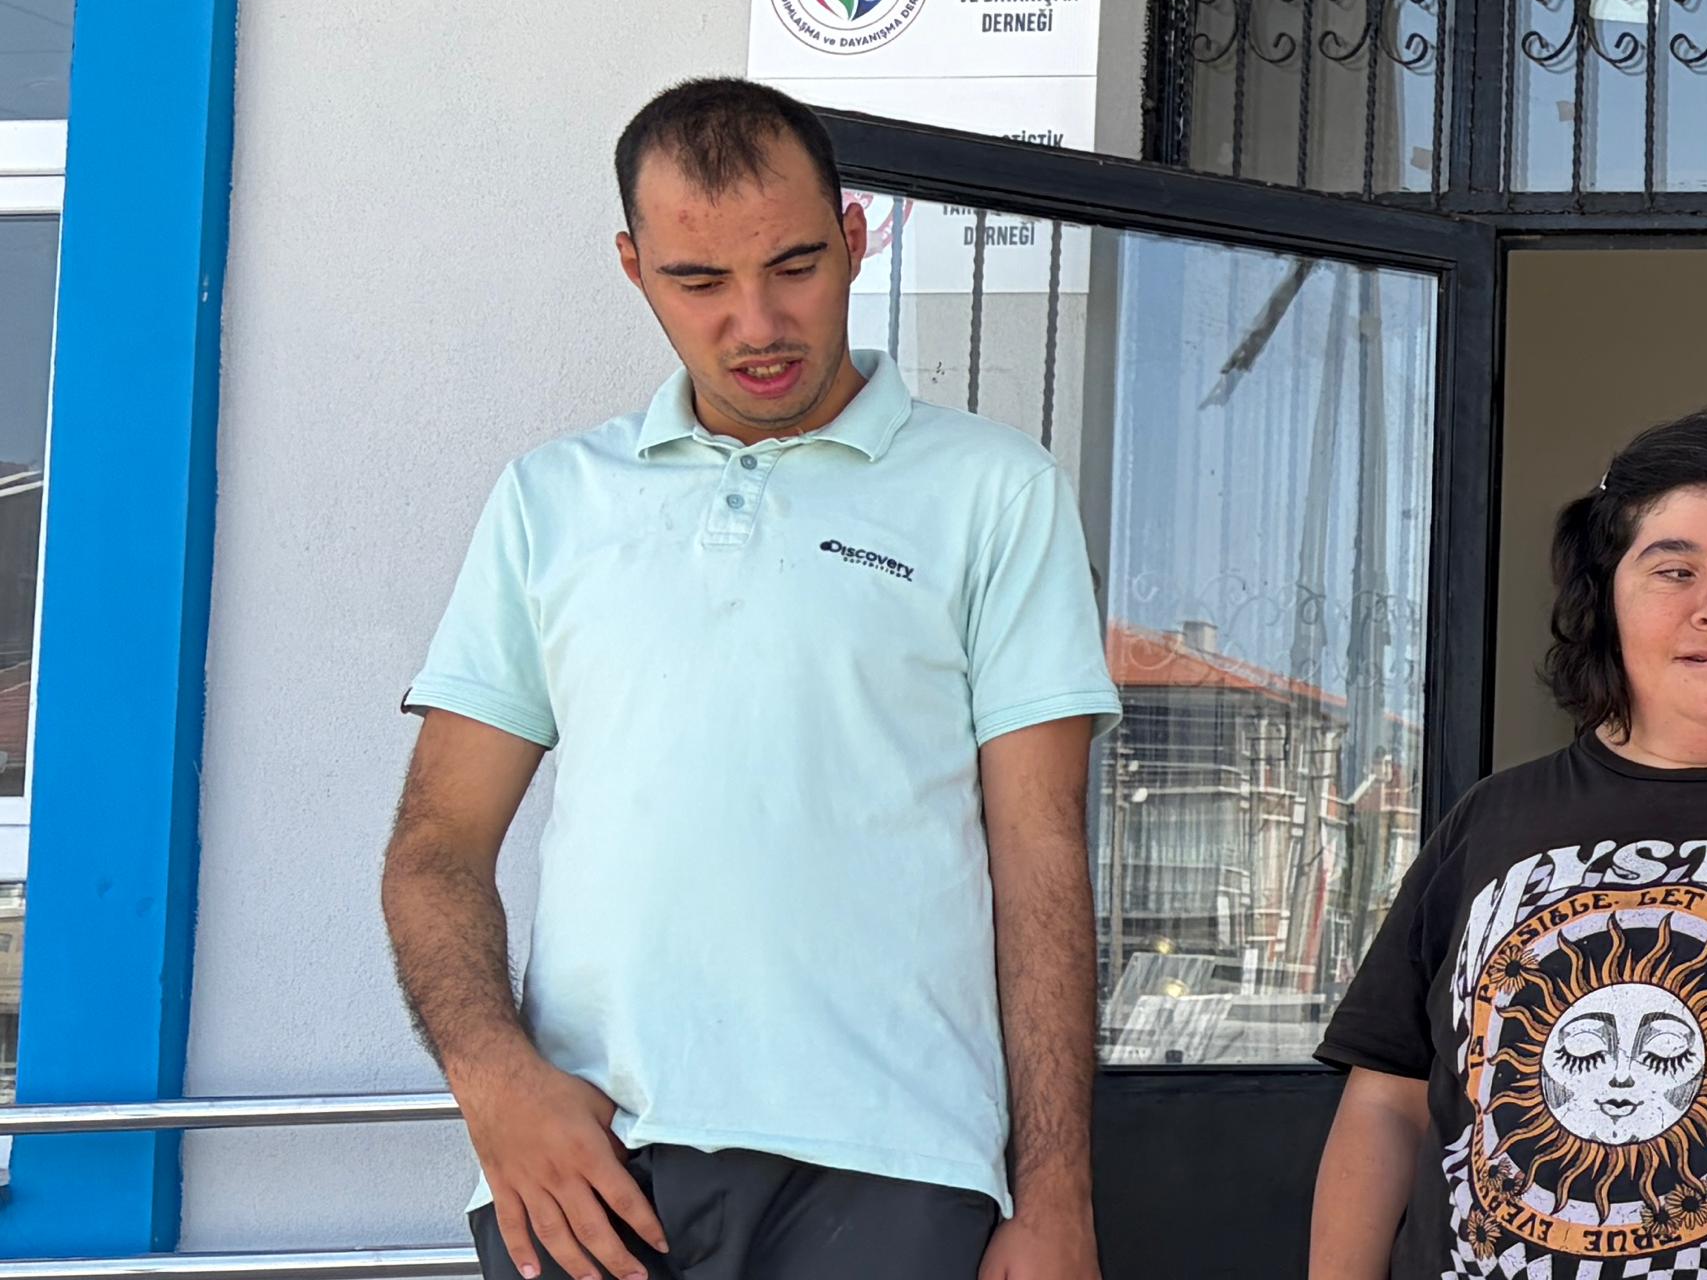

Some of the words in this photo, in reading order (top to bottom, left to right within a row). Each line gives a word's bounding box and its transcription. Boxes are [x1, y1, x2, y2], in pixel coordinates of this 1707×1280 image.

[982, 8, 1053, 32] DERNEĞİ
[964, 221, 1035, 246] DRNEĞİ
[1637, 888, 1705, 911] LET
